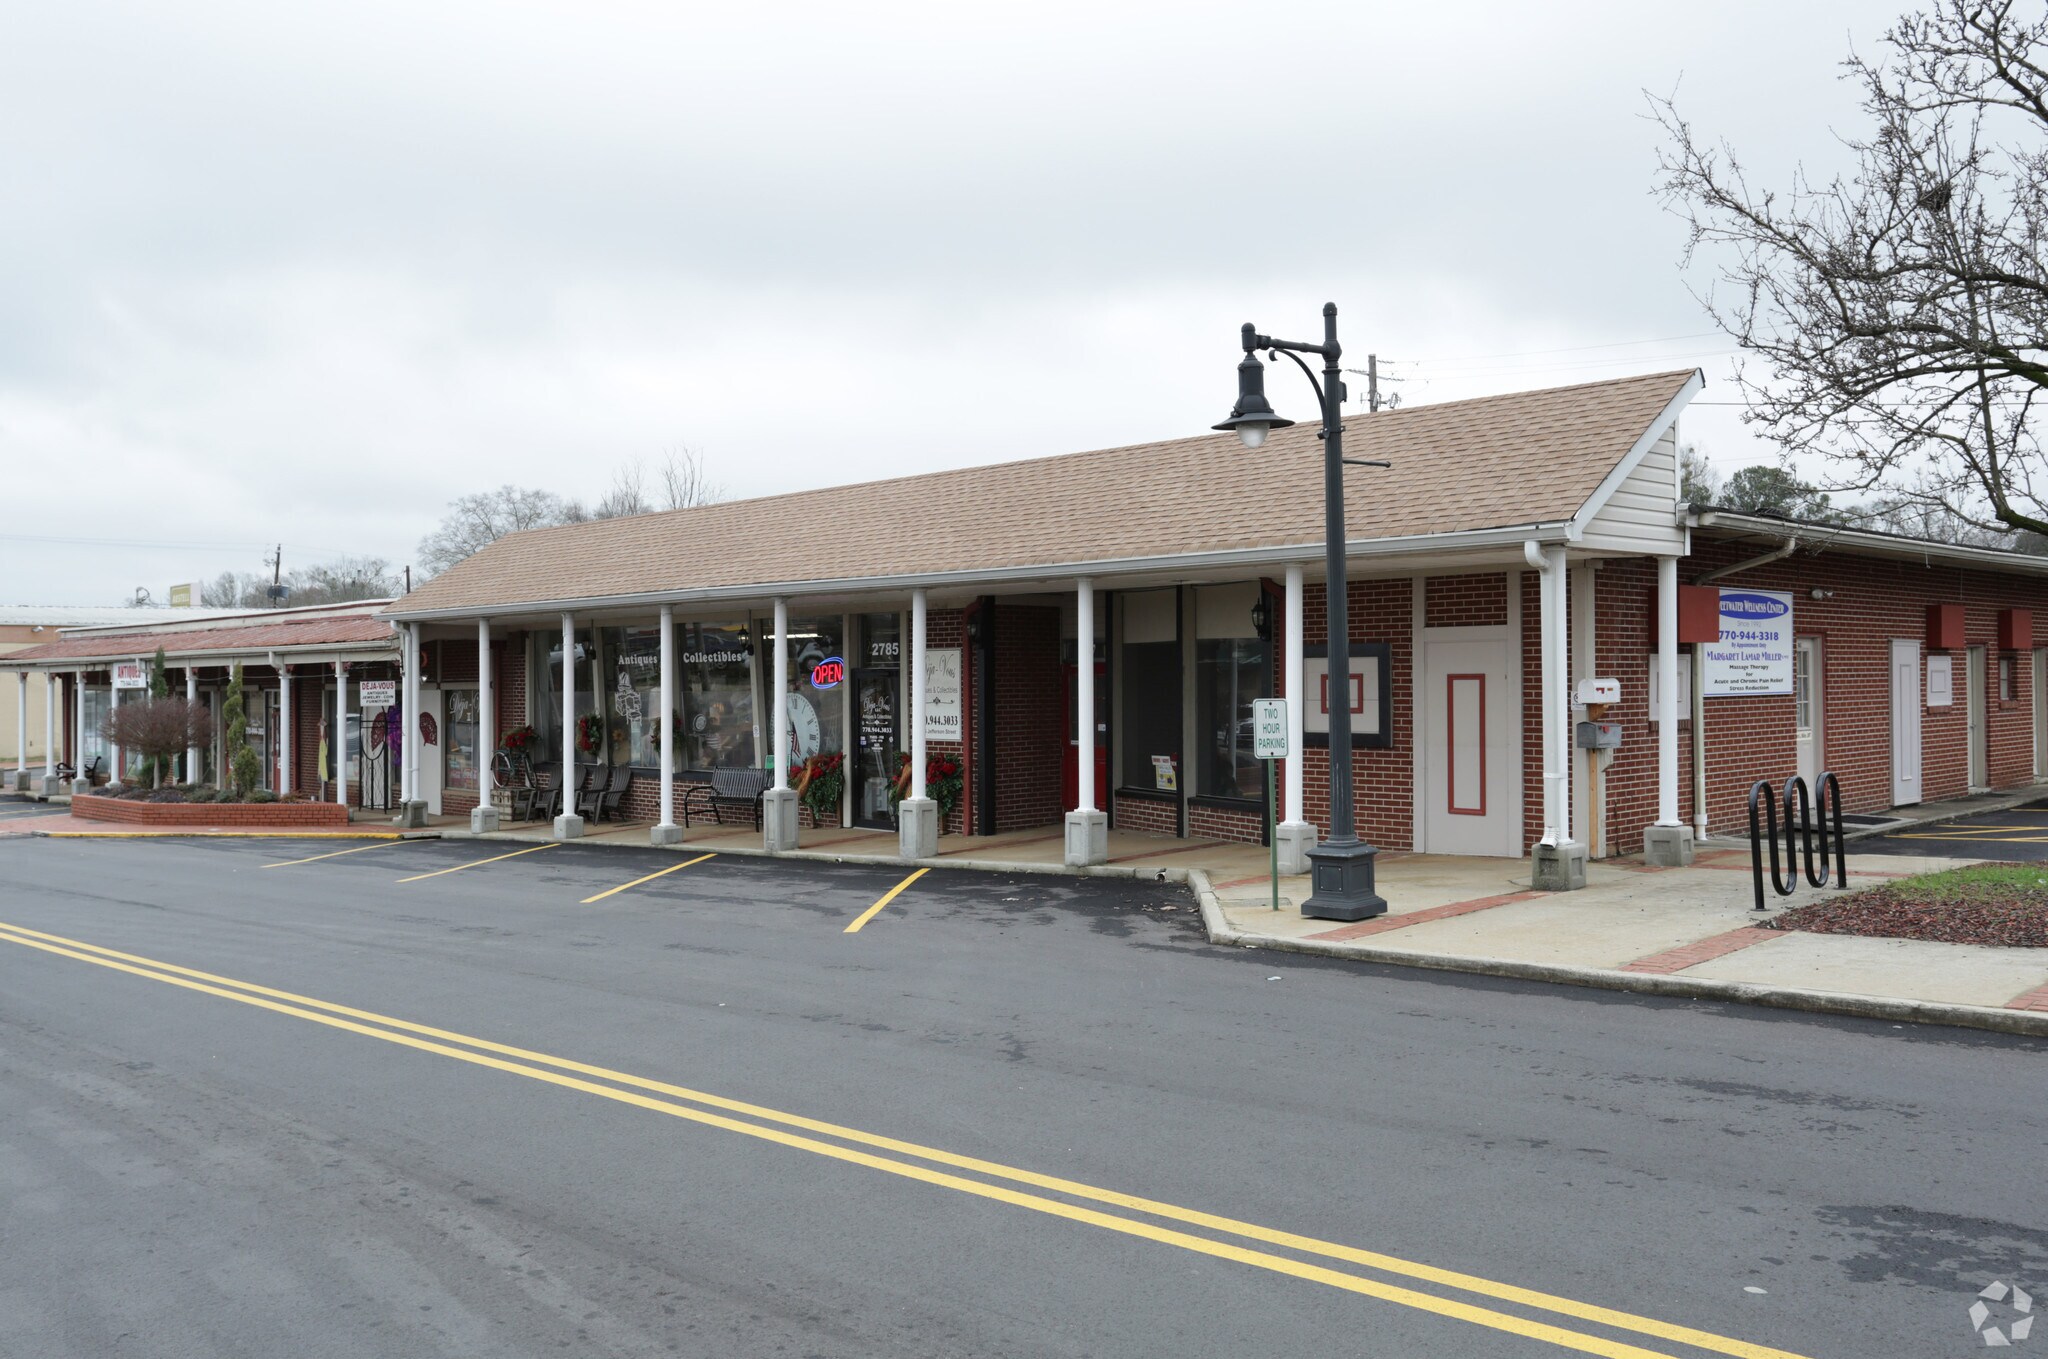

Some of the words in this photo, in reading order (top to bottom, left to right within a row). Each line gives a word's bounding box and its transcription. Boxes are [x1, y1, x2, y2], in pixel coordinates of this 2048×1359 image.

[1719, 601, 1744, 612] EETWATER
[1744, 600, 1766, 613] WELLNESS
[1767, 602, 1785, 614] CENTER
[1719, 631, 1780, 641] 770-944-3318
[872, 643, 900, 656] 2785
[618, 655, 658, 666] Antiques
[683, 652, 743, 663] Collectibles
[1707, 651, 1740, 661] MARGARET
[1741, 652, 1761, 661] LAMAR
[1761, 652, 1782, 661] MILLER
[814, 664, 842, 684] OPEN
[1264, 708, 1278, 719] TWO
[1262, 723, 1280, 734] HOUR
[1258, 738, 1285, 749] PARKING
